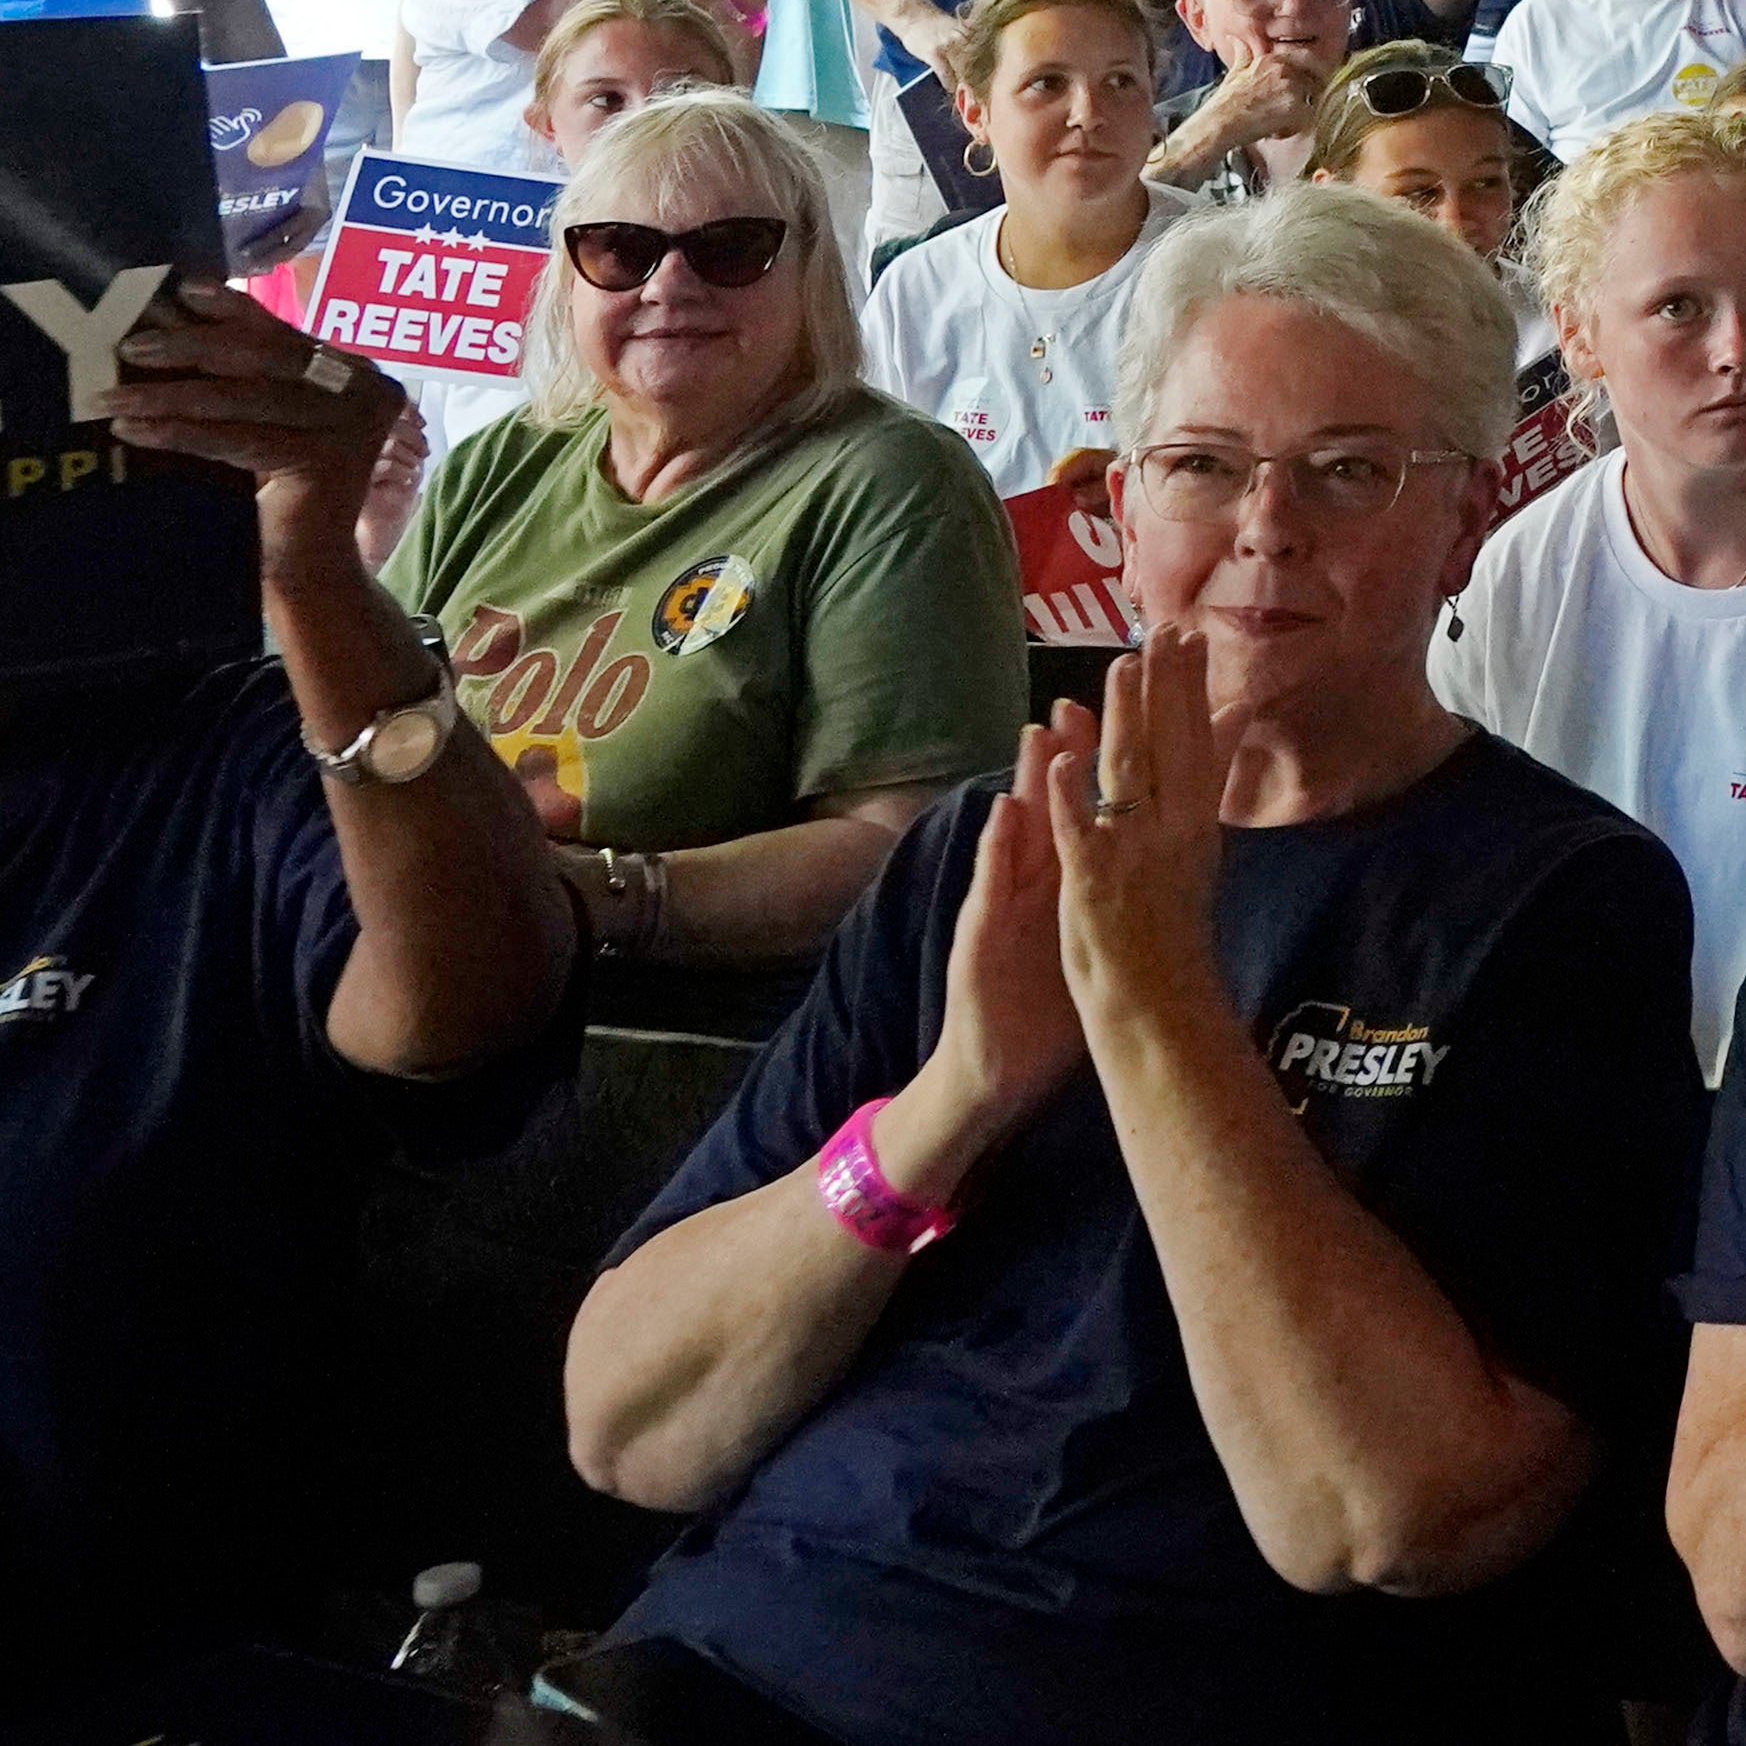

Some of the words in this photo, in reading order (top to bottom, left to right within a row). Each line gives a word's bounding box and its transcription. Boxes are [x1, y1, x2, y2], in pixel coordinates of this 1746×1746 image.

[218, 188, 299, 216] ESLEY
[373, 175, 552, 229] Governor
[377, 249, 508, 308] TATE
[318, 299, 524, 365] REEVES
[450, 603, 653, 743] Polo
[1278, 1032, 1451, 1086] PRESLEY
[1350, 1020, 1430, 1044] Brandon
